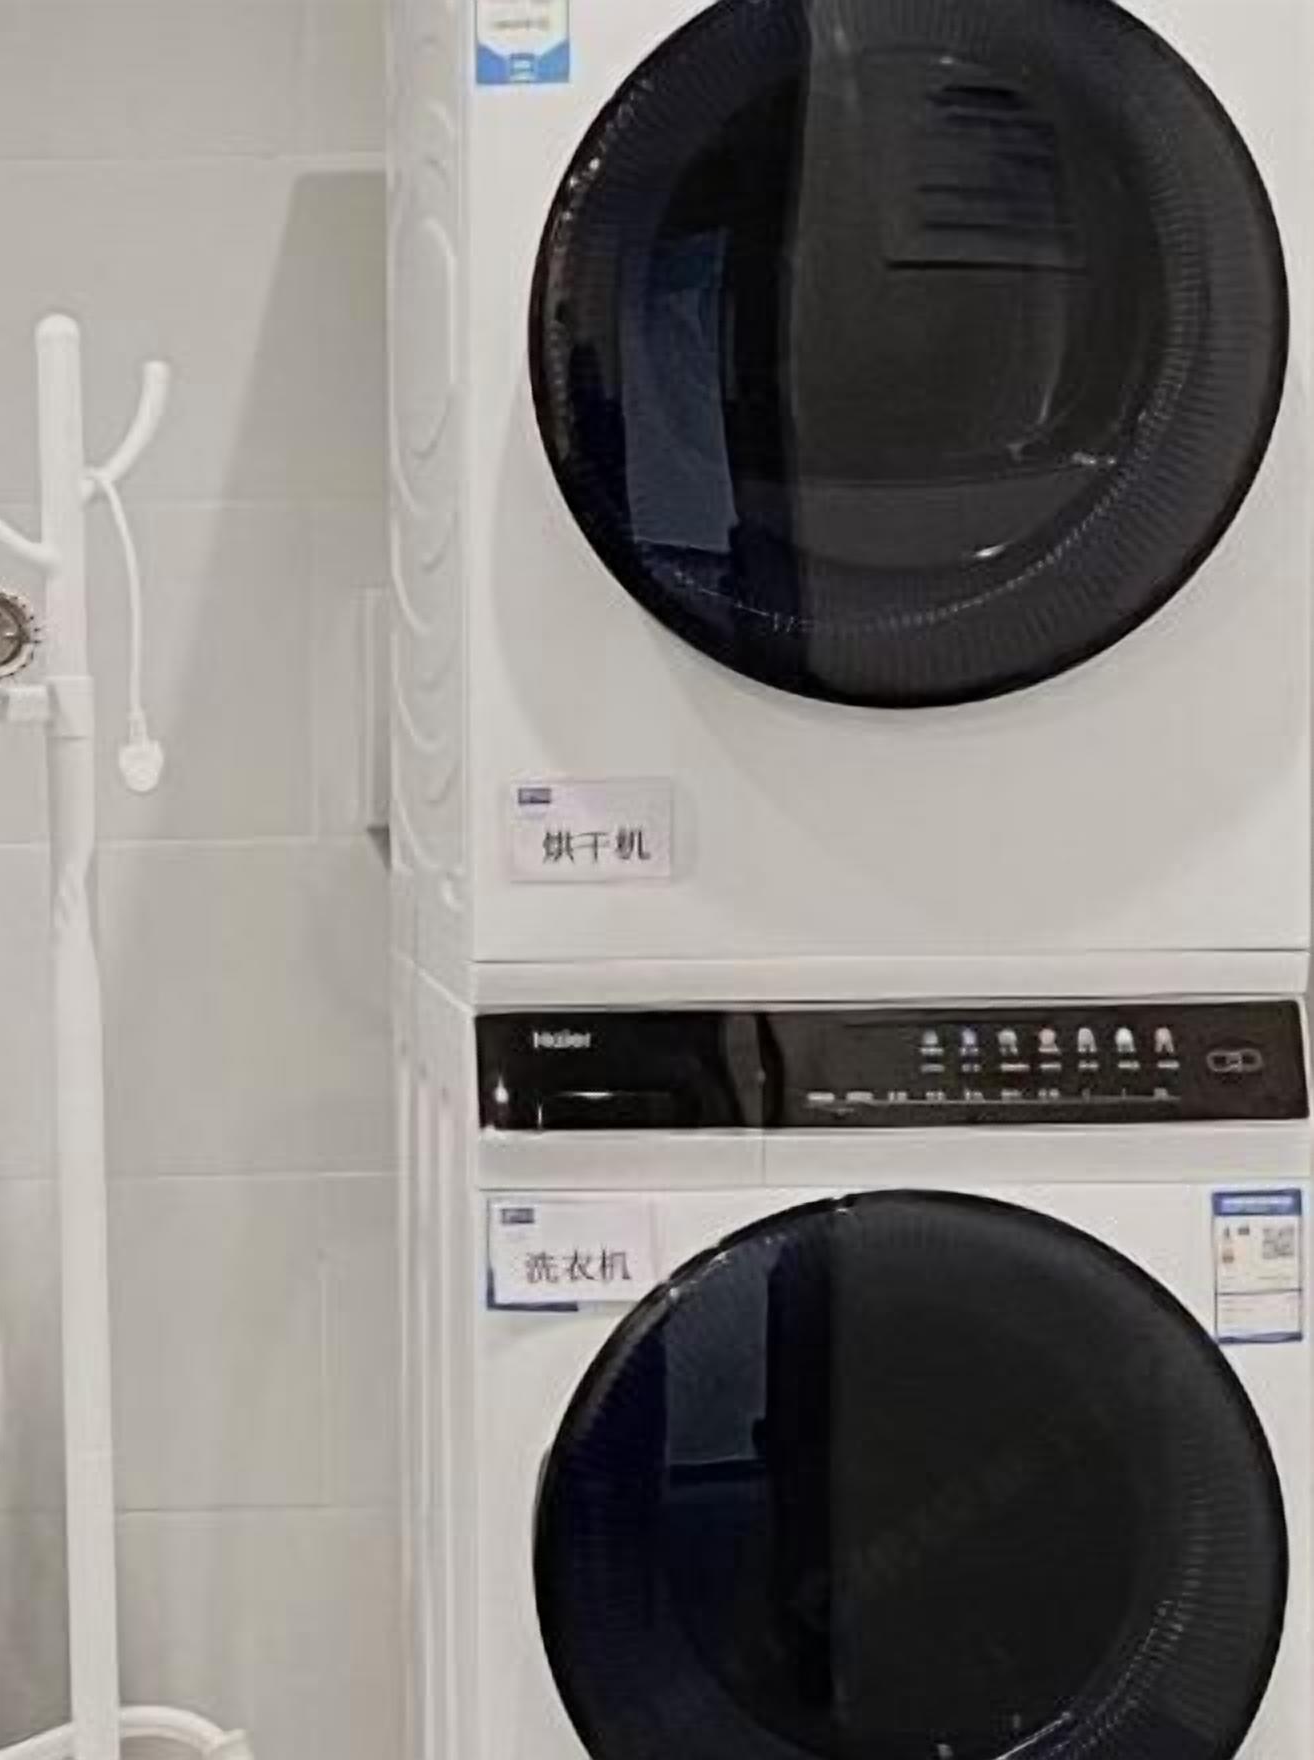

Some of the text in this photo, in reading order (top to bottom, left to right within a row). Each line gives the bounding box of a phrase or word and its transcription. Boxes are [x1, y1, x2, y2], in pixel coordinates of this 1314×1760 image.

[542, 830, 651, 864] 烘干机
[524, 1248, 632, 1285] 洗衣机
